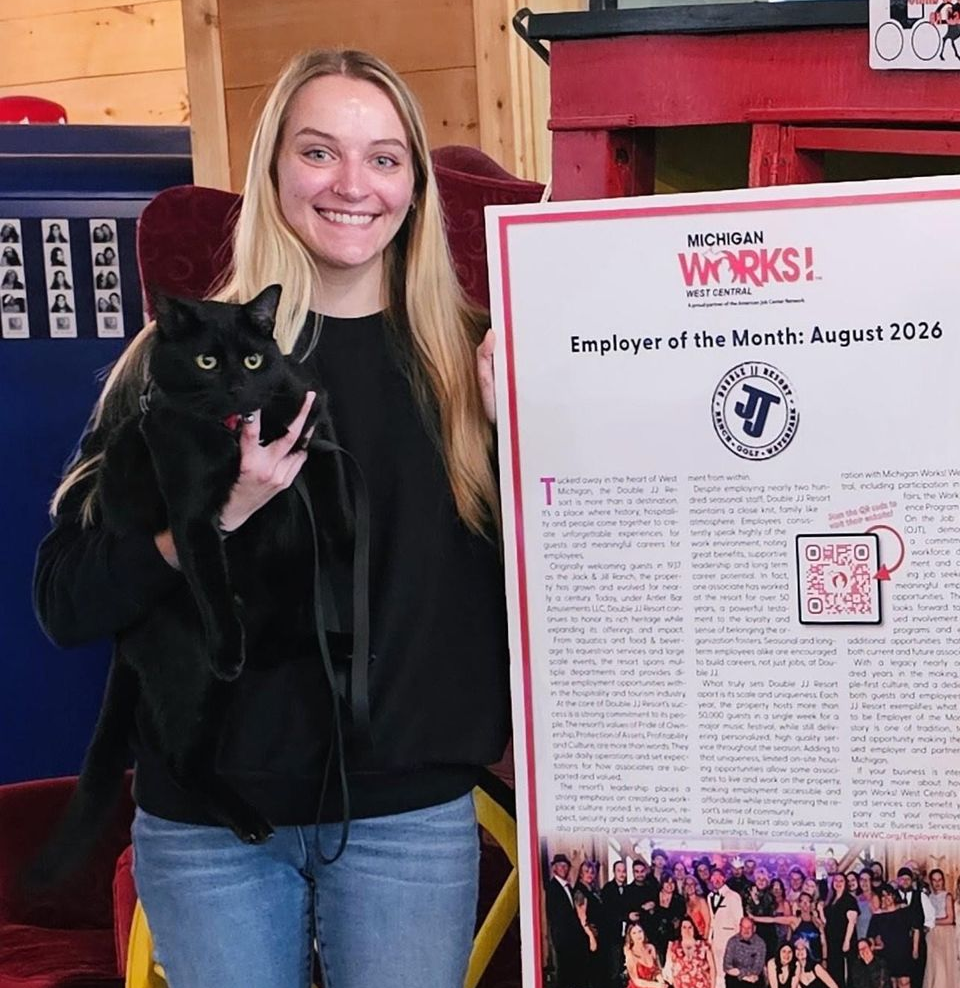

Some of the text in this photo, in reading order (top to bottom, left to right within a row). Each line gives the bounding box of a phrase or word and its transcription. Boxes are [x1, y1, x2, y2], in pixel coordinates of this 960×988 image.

[687, 230, 764, 248] MICHIGAN
[678, 246, 814, 287] WORKS!
[686, 287, 752, 298] WEST CENTRAL
[570, 321, 943, 357] Employer of the Month: August 2026
[736, 445, 759, 457] GOLF
[582, 477, 602, 485] away
[612, 475, 624, 483] the
[626, 474, 647, 482] heart
[659, 473, 677, 482] West
[841, 470, 864, 479] ration
[865, 470, 881, 478] with
[883, 470, 919, 479] Michigan
[694, 484, 721, 493] Despite
[724, 483, 765, 493] employing
[768, 483, 791, 492] nearly
[794, 483, 809, 491] two
[860, 481, 895, 491] including
[898, 480, 949, 490] participation
[859, 506, 870, 514] QR
[926, 502, 959, 512] Program
[552, 519, 567, 527] and
[569, 518, 594, 528] people
[619, 518, 651, 528] together
[543, 540, 567, 550] guests
[572, 540, 587, 548] and
[591, 540, 632, 549] meaningful
[670, 540, 680, 548] for
[691, 560, 788, 570] leadership and long term
[746, 582, 759, 590] has
[761, 582, 789, 590] worked
[895, 580, 938, 590] meaningful
[705, 593, 716, 601] the
[720, 593, 742, 601] resort
[746, 593, 756, 601] for
[847, 636, 886, 644] additional
[890, 636, 941, 646] opportunities
[548, 648, 564, 656] age
[576, 647, 614, 656] equestrian
[649, 646, 663, 654] and
[666, 646, 684, 656] large
[696, 647, 713, 655] term
[715, 647, 755, 656] employees
[757, 647, 773, 655] alike
[790, 647, 837, 656] encouraged
[571, 679, 615, 688] employment
[617, 679, 665, 688] opportunities
[703, 679, 723, 687] What
[728, 679, 745, 689] truly
[814, 680, 838, 688] Resort
[852, 777, 884, 787] learning
[918, 778, 941, 786] about
[701, 785, 729, 794] making
[732, 785, 778, 795] employment
[826, 787, 841, 795] and
[555, 793, 578, 802] strong
[580, 793, 614, 803] emphasis
[628, 794, 659, 804] creating
[853, 820, 868, 828] tact
[928, 821, 960, 830] Services
